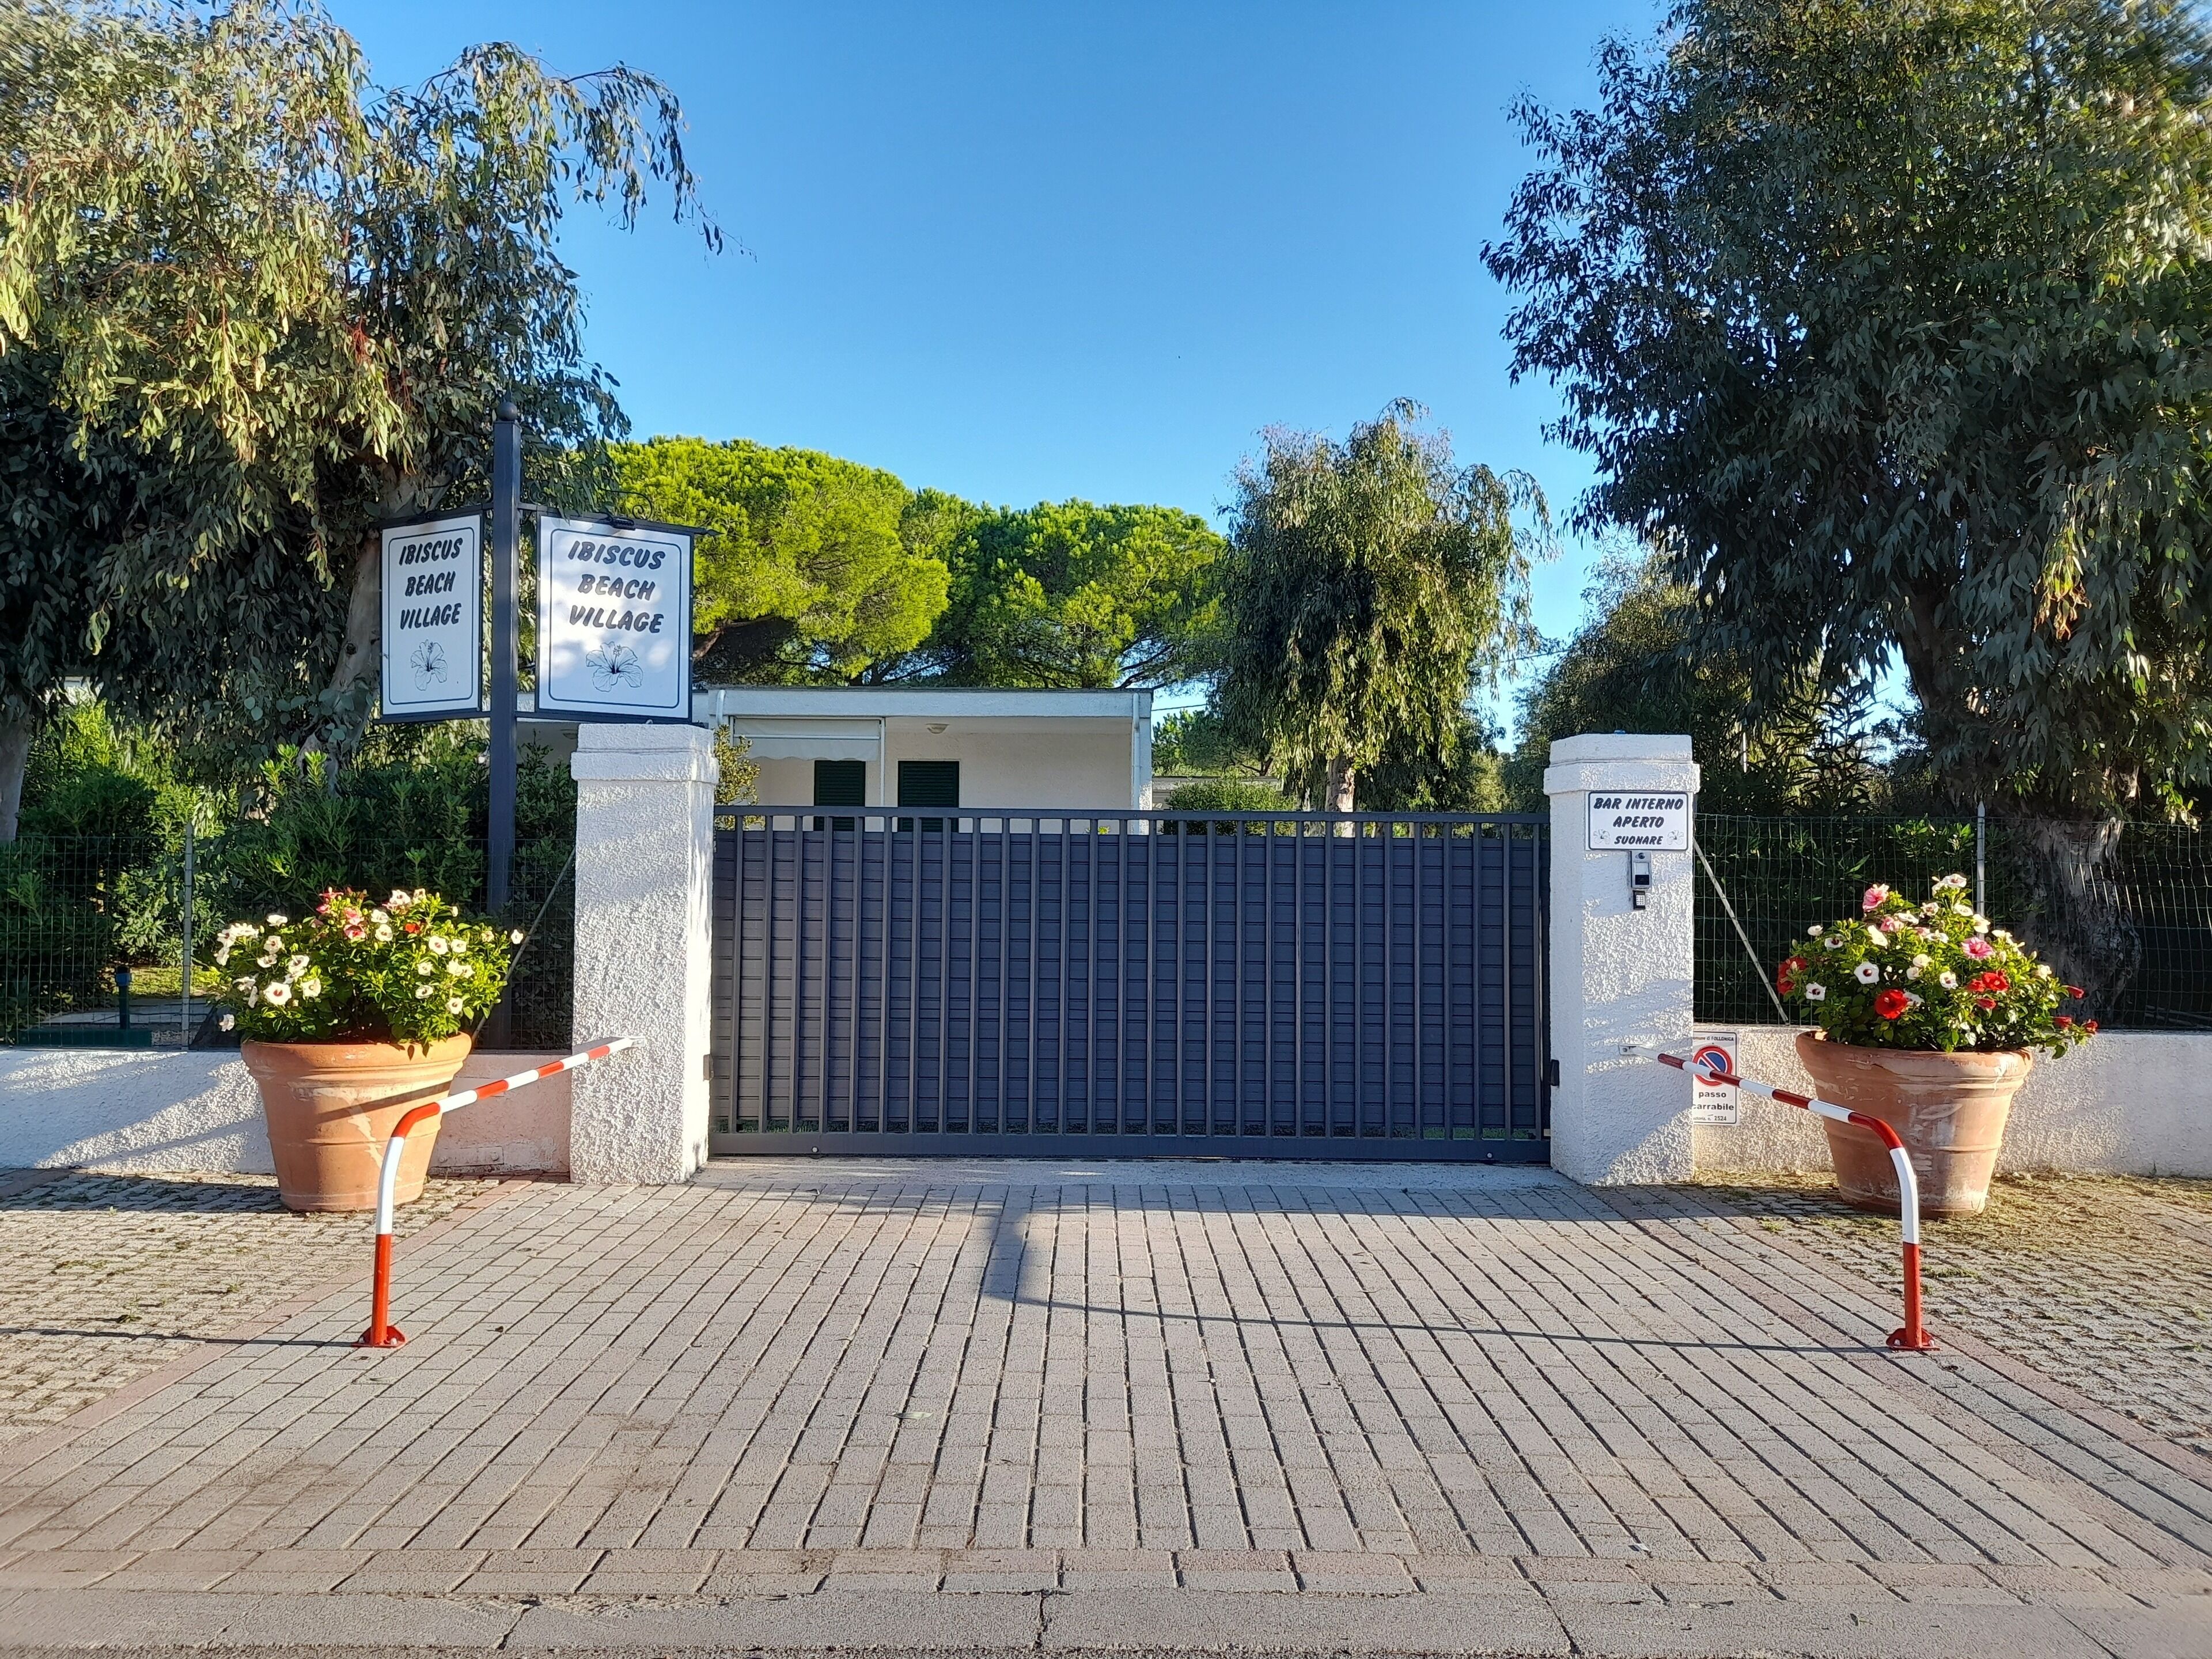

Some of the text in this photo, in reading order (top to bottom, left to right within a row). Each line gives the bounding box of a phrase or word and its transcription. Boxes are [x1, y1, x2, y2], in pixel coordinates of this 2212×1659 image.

[399, 537, 463, 566] IBISCUS
[567, 540, 666, 570] IBISCUS
[404, 571, 456, 597] BEACH
[577, 574, 656, 601] BEACH
[400, 603, 462, 630] VILLAGE
[569, 605, 664, 633] VILLAGE
[1593, 797, 1684, 810] BAR INTERNO
[1613, 816, 1664, 828] APERTO
[1614, 835, 1664, 845] SUONARE
